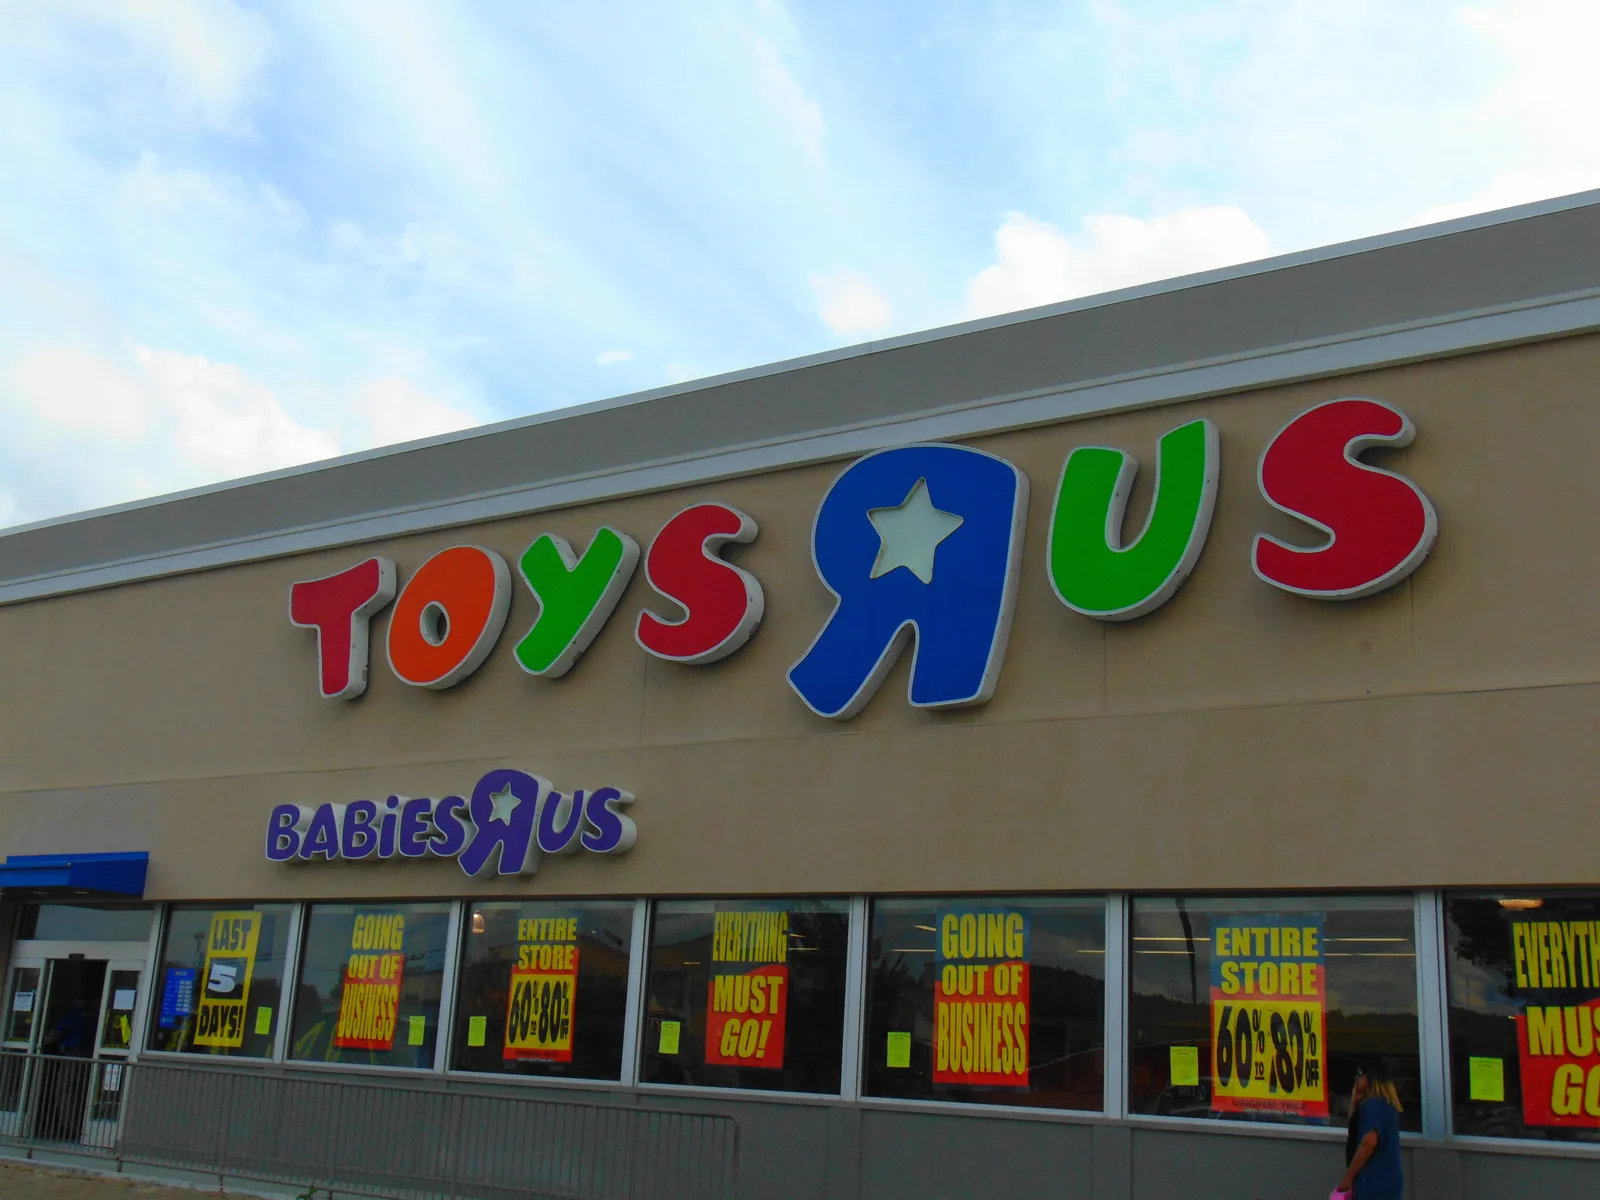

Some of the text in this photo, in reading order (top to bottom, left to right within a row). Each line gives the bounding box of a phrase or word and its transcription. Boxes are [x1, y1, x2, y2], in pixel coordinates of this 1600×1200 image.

[288, 396, 1438, 721] TOYS R US
[458, 768, 554, 877] R
[537, 785, 637, 855] US
[212, 918, 253, 951] LAST
[352, 914, 404, 949] GOING
[517, 917, 578, 941] ENTIRE
[712, 911, 788, 963] EVERYTHING
[941, 912, 1024, 959] GOING
[1216, 927, 1319, 957] ENTIRE
[348, 954, 401, 980] OUT OF
[517, 944, 575, 970] STORE
[207, 963, 238, 993] 5
[713, 974, 784, 1014] MUST
[941, 965, 1024, 996] OUT OF
[1221, 961, 1318, 996] STORE
[198, 1004, 244, 1039] DAYS!
[338, 983, 398, 1041] BUSINESS
[508, 979, 540, 1044] 60%
[719, 1017, 772, 1059] GO!
[936, 1001, 1027, 1076] BUSINESS
[1216, 1005, 1266, 1089] 60%
[1305, 1058, 1320, 1088] OFF
